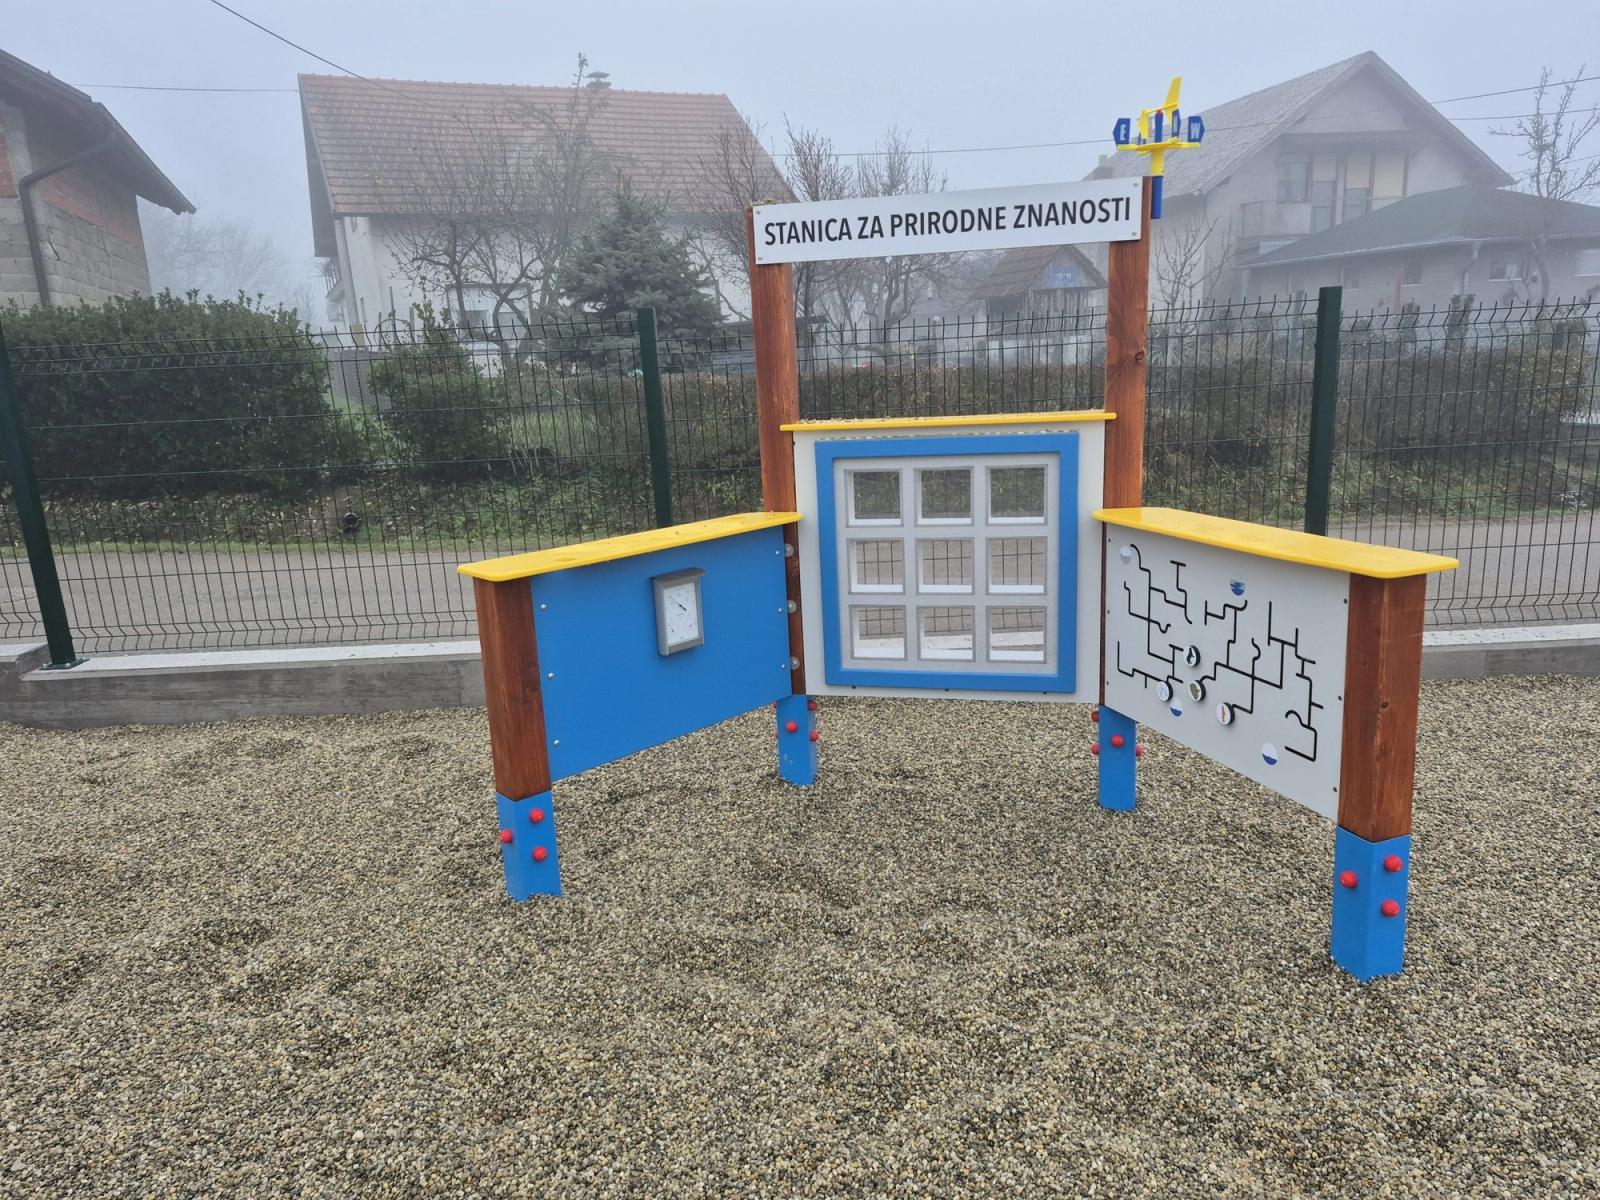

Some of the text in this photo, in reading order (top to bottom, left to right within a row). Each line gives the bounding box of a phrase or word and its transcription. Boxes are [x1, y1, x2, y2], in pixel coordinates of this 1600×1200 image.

[1190, 122, 1201, 139] W
[764, 196, 1131, 246] STANICA ZA PRIRODNE ZNANOSTI
